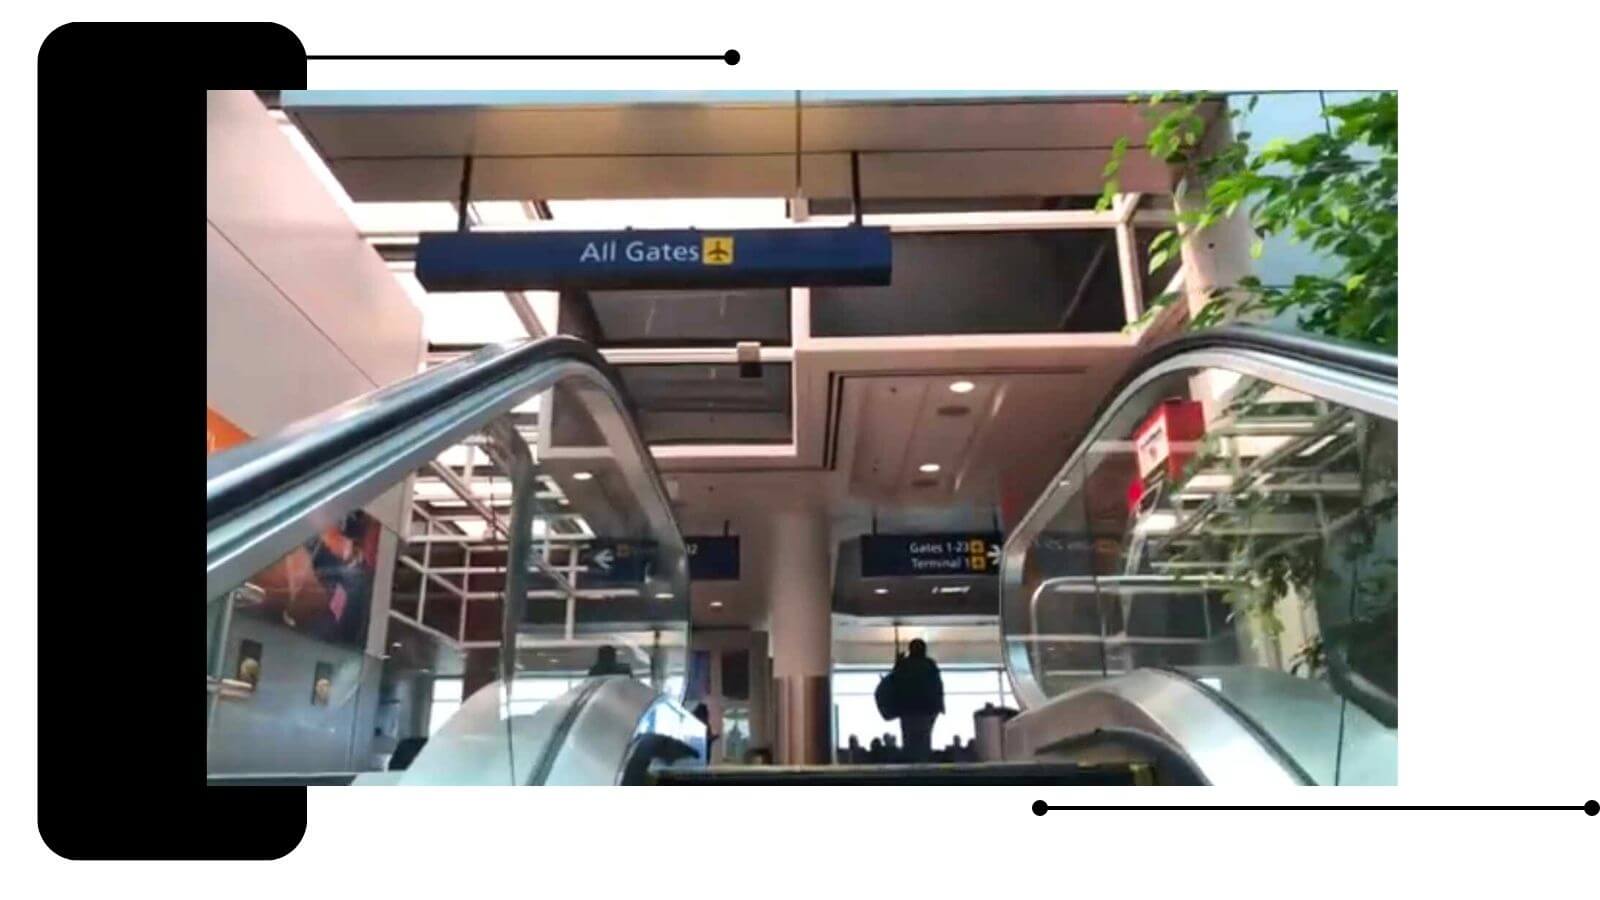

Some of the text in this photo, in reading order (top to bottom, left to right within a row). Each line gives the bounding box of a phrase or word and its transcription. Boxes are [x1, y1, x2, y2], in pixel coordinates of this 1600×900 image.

[579, 240, 700, 263] All Gates
[909, 542, 943, 553] Gates
[911, 557, 962, 570] Terminal
